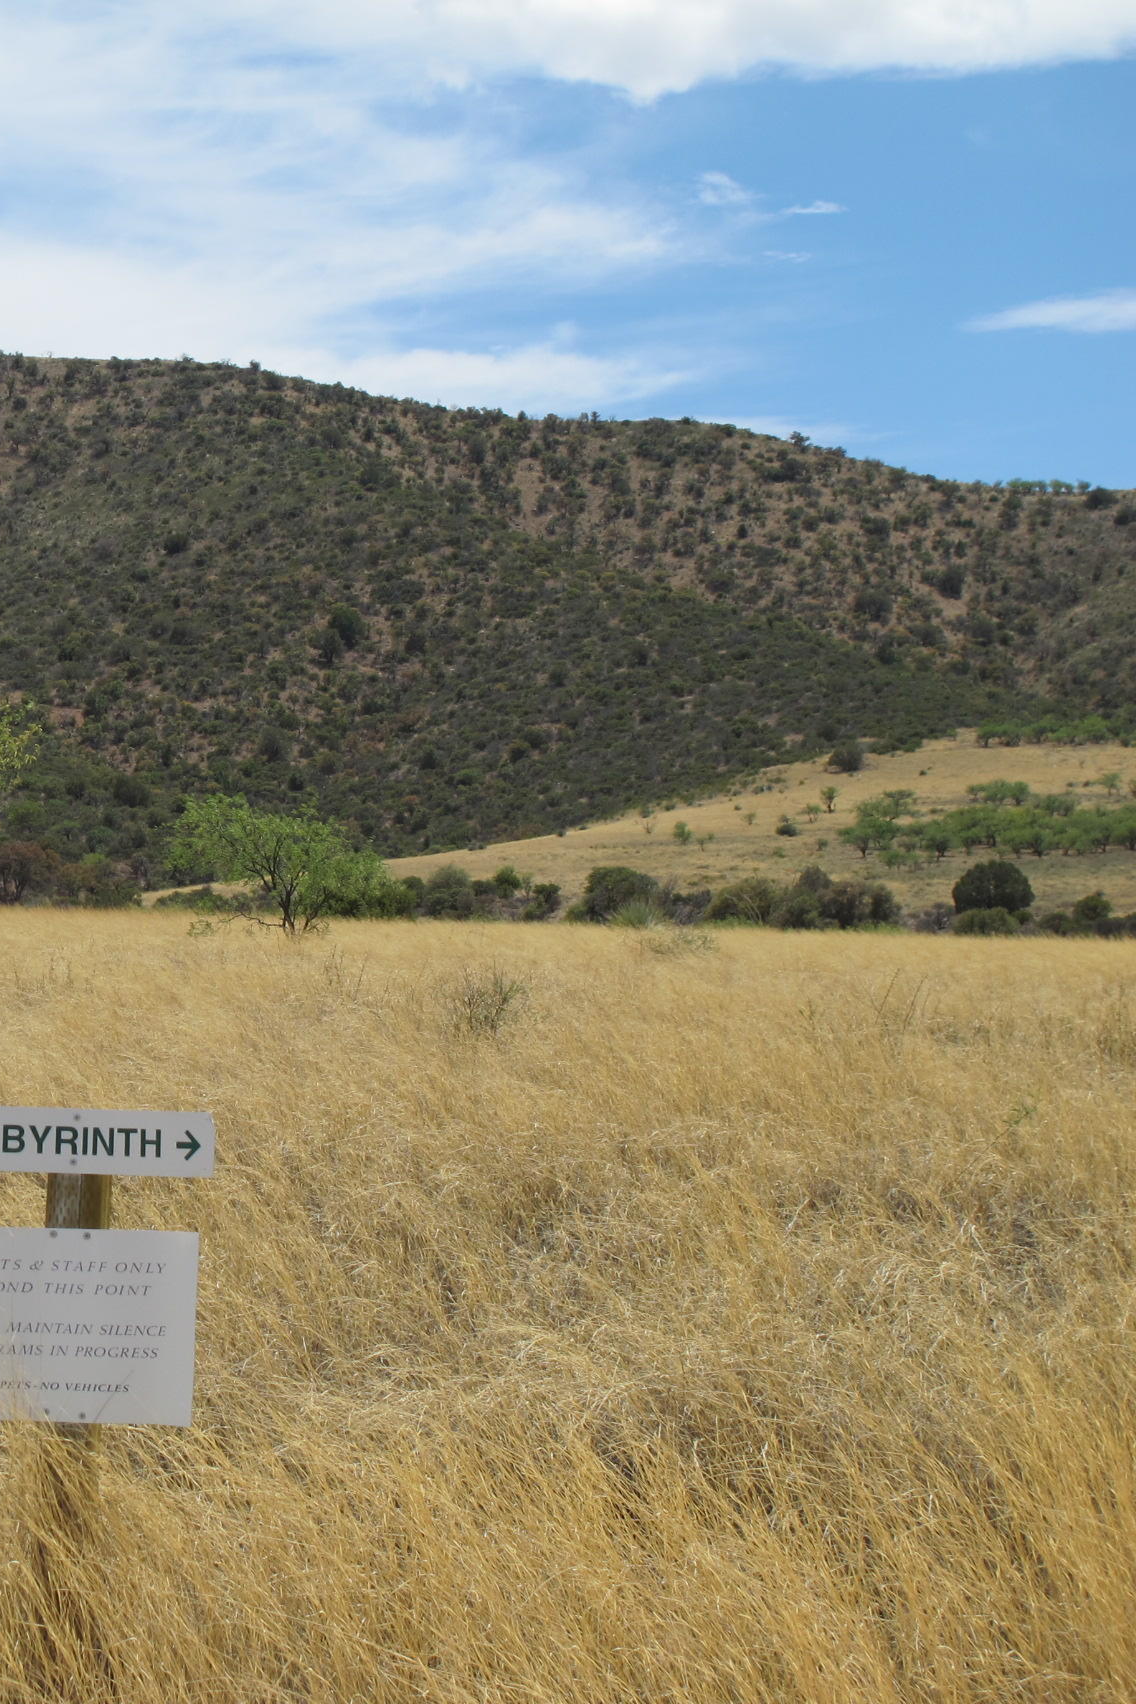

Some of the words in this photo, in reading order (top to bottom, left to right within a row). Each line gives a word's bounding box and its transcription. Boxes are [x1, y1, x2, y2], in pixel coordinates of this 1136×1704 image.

[29, 1260, 44, 1272] &
[51, 1260, 108, 1274] STAFF
[115, 1262, 166, 1275] ONLY
[44, 1283, 84, 1296] THIS
[94, 1284, 152, 1297] POINT
[5, 1321, 93, 1336] MAINTAIN
[98, 1324, 167, 1338] SILENCE
[49, 1345, 68, 1357] IN
[74, 1346, 159, 1360] PROGRESS
[65, 1383, 130, 1394] VEHICLES
